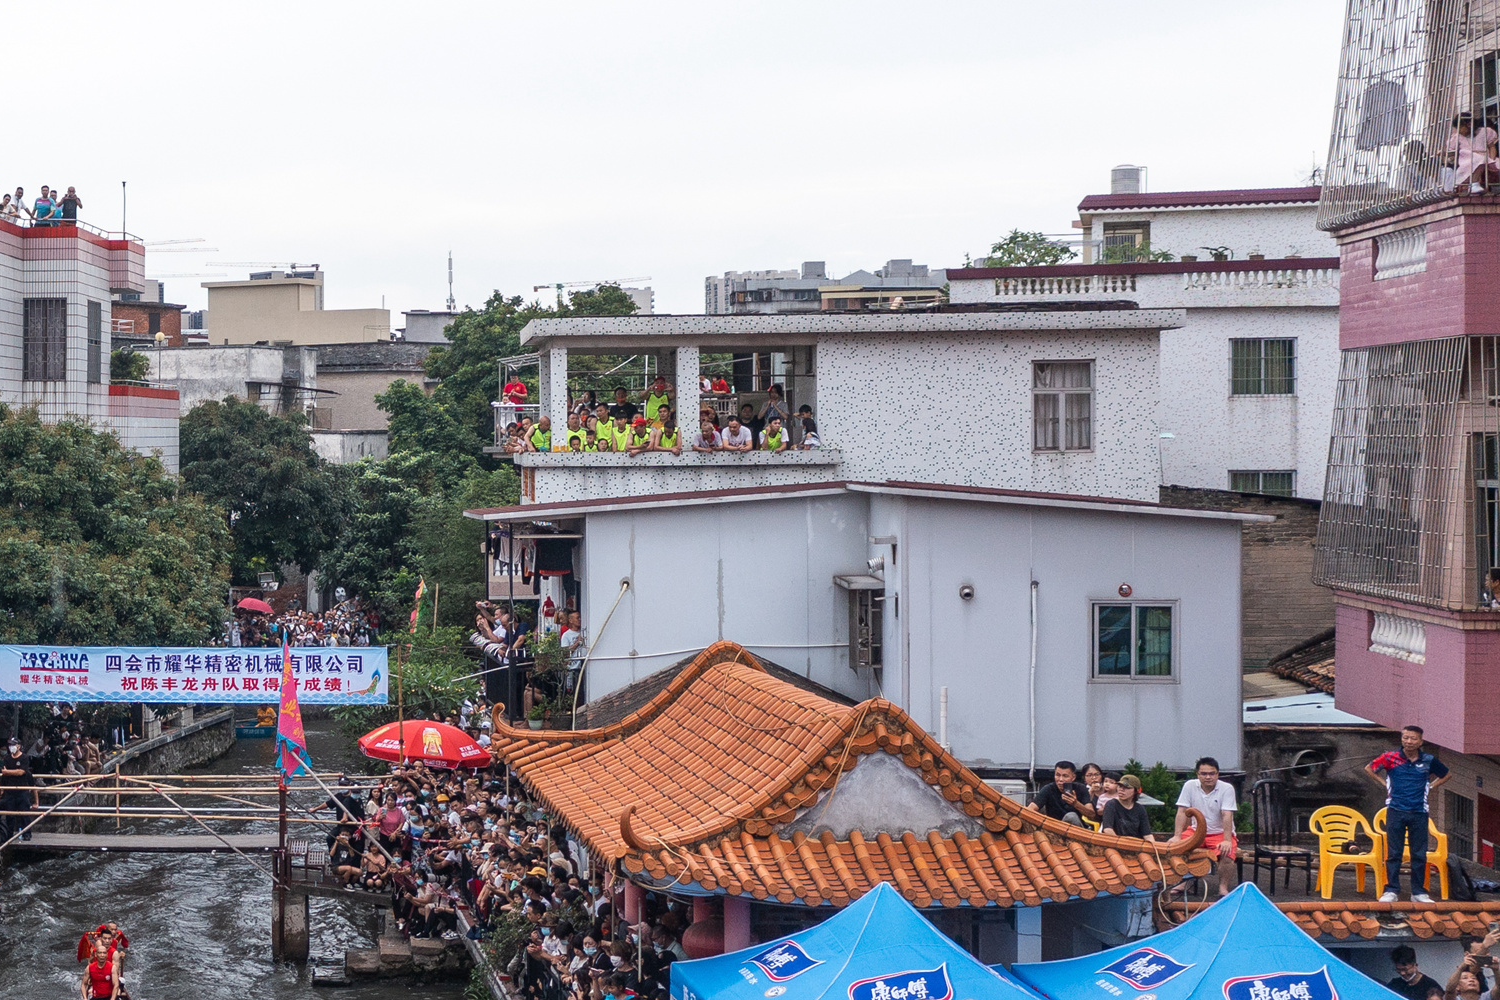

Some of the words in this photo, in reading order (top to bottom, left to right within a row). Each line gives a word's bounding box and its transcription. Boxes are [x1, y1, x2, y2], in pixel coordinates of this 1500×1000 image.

[20, 659, 89, 670] MACHINE
[19, 674, 89, 686] 耀华精密机械
